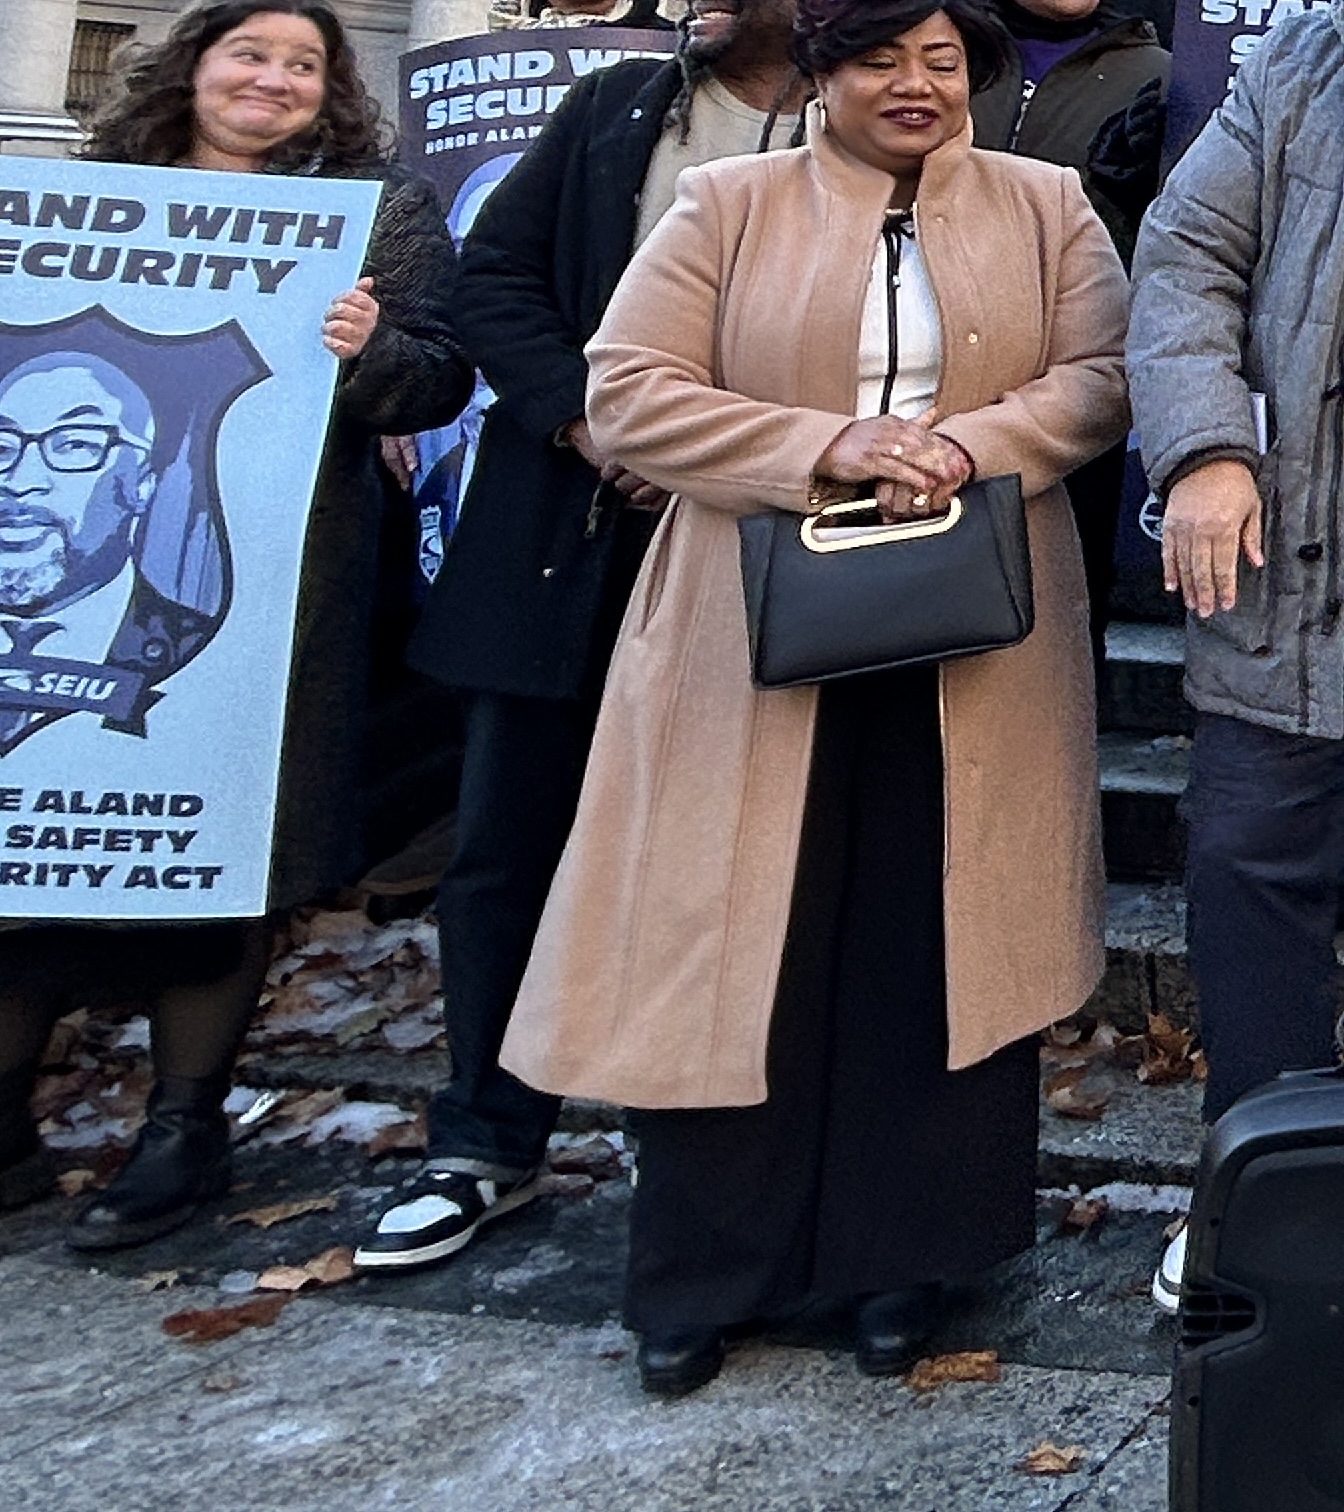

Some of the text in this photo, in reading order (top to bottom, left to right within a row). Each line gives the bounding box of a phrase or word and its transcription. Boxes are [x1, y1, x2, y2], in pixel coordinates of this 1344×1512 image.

[410, 50, 555, 100] STAND
[426, 84, 571, 130] SECU
[425, 132, 479, 155] HONOR
[0, 190, 346, 250] AND WITH
[0, 239, 297, 294] ECURITY
[35, 672, 119, 700] SEIU
[33, 789, 204, 818] ALAND
[4, 824, 198, 854] SAFETY
[0, 862, 224, 890] RITY ACT
